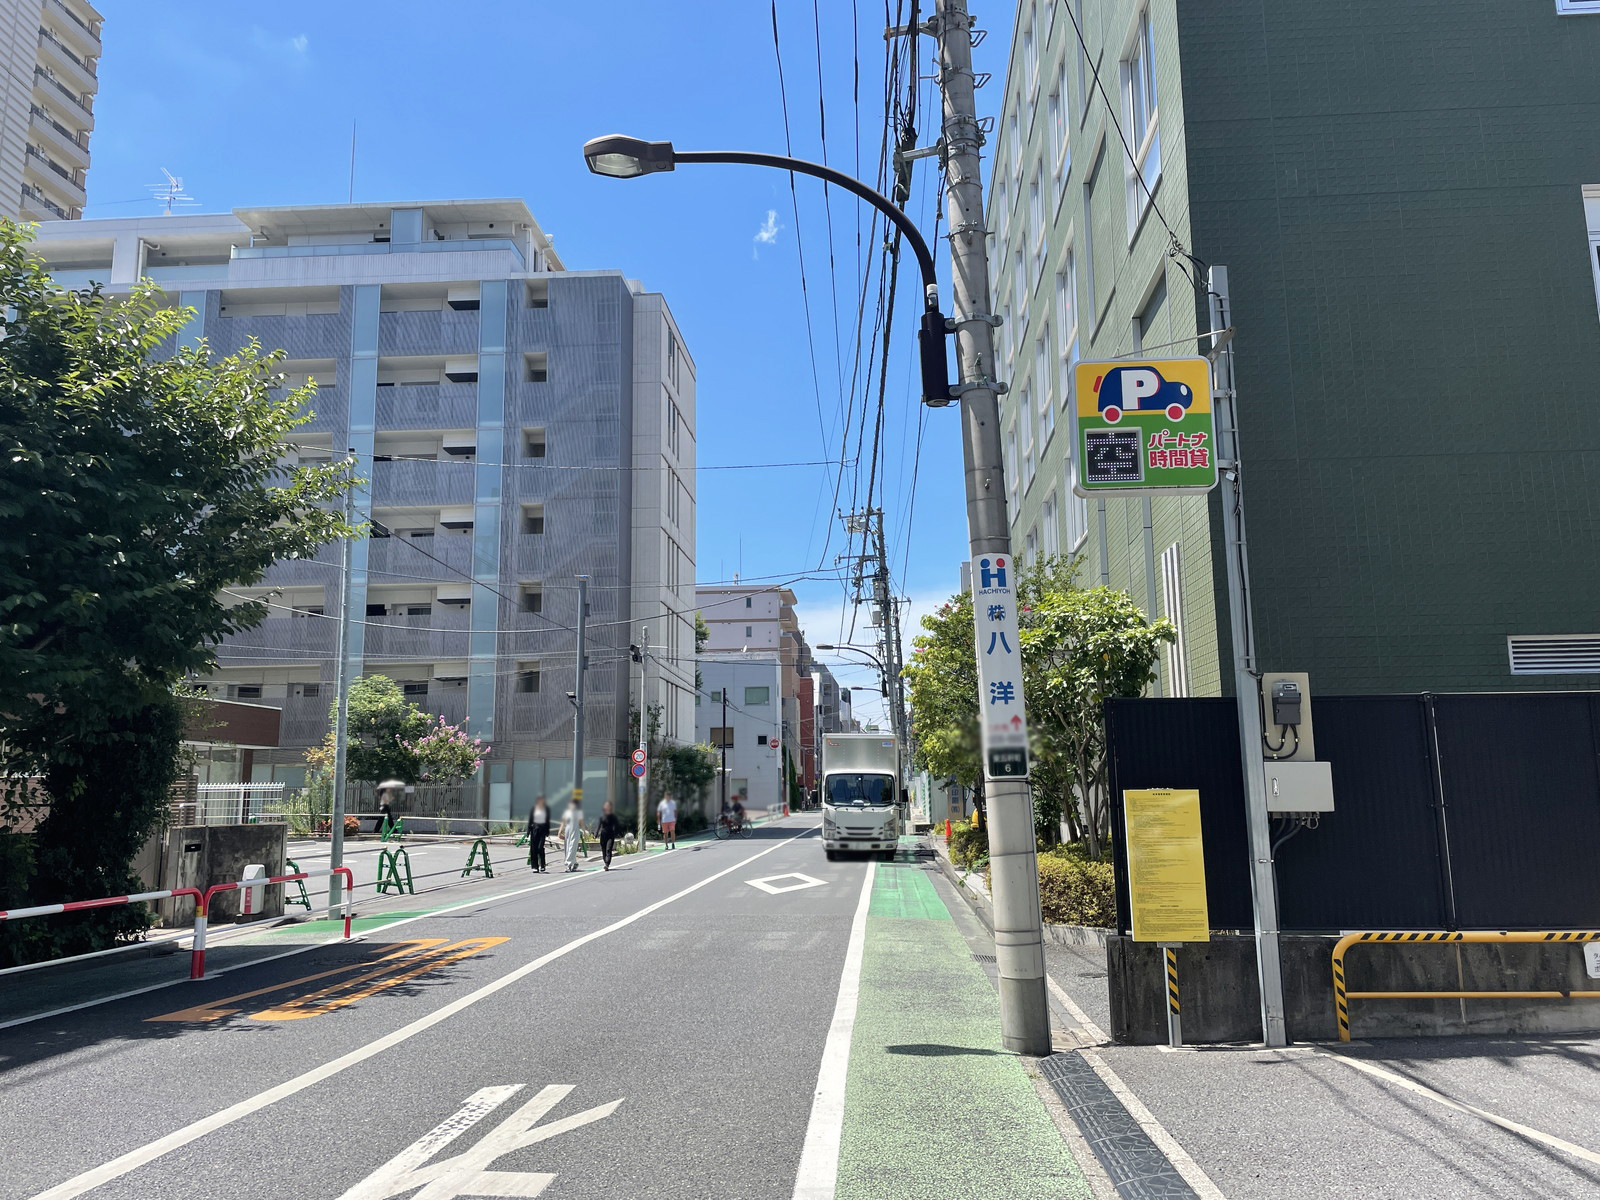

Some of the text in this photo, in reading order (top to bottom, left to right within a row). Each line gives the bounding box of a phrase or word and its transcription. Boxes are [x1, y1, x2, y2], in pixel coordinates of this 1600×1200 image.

[1121, 369, 1161, 410] P
[1148, 429, 1208, 449] パートナ
[1087, 432, 1140, 481] 空
[1149, 449, 1209, 469] 時間貸
[978, 588, 1010, 596] HACHIYOH
[1004, 763, 1012, 773] 6
[143, 936, 512, 1022] 20
